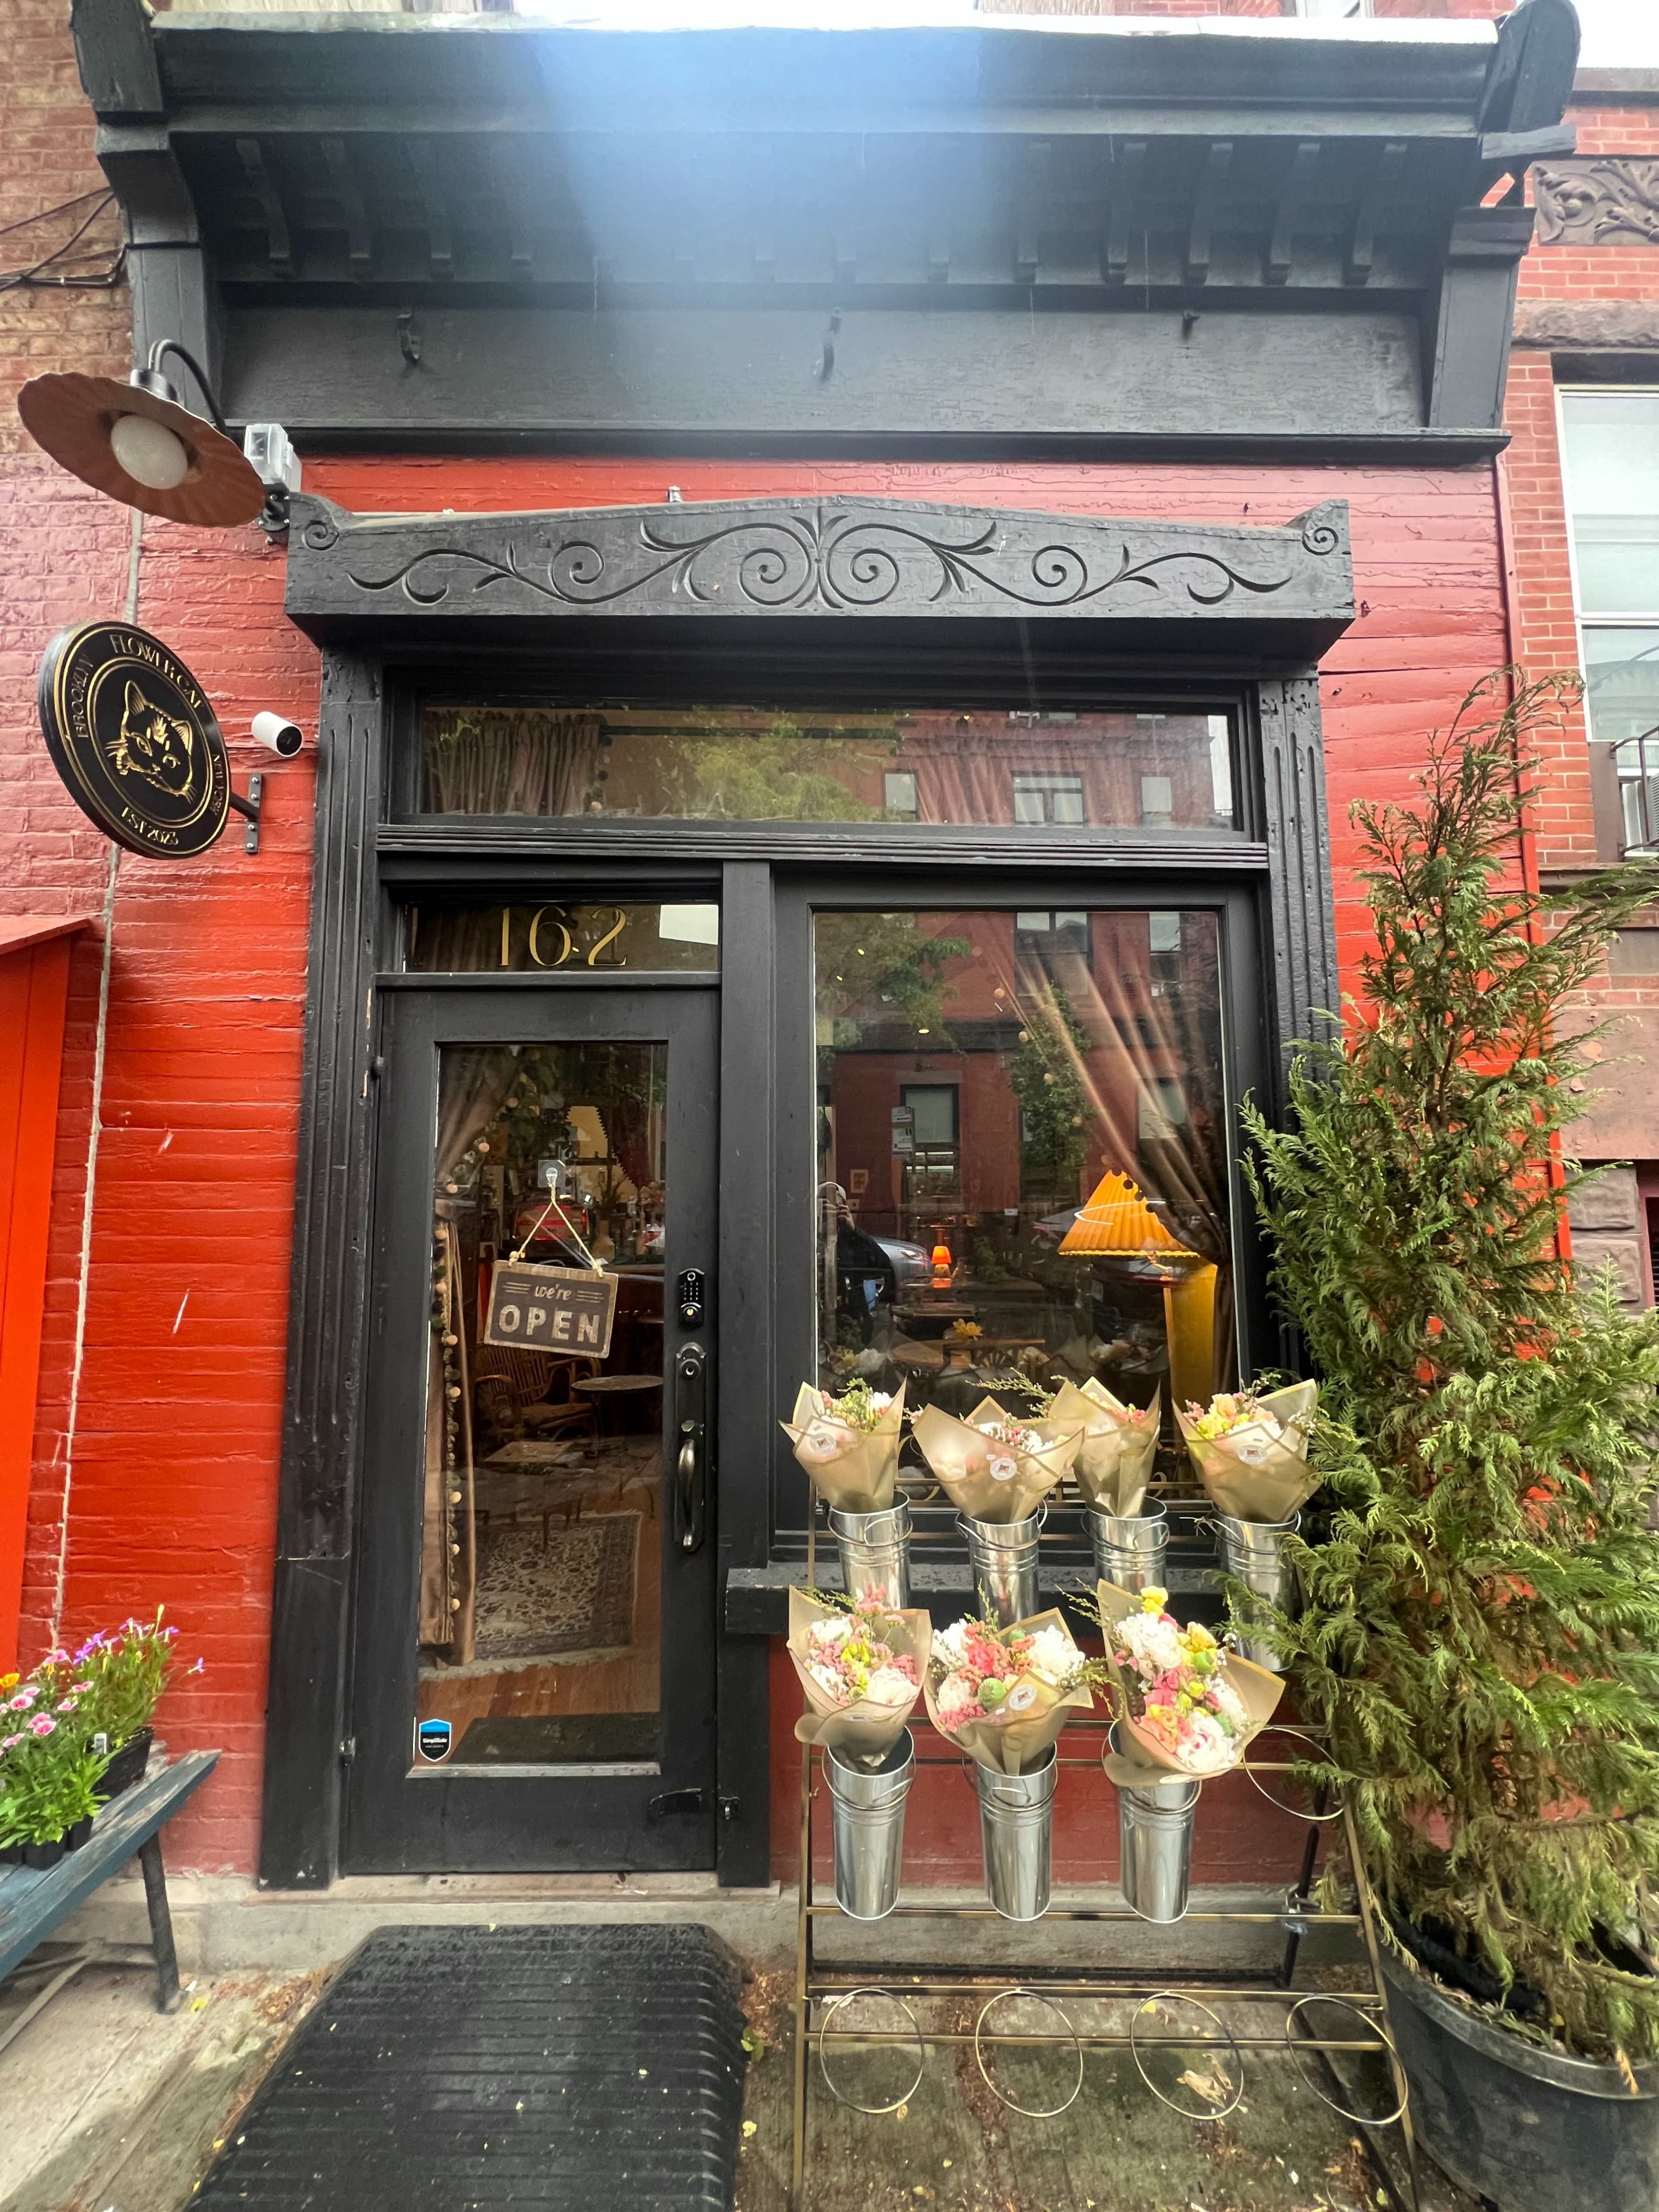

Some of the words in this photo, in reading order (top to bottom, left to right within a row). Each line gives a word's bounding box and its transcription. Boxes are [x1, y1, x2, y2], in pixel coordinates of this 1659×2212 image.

[147, 826, 178, 845] 2023
[499, 906, 627, 966] 162
[534, 1283, 572, 1301] we're
[499, 1304, 600, 1344] OPEN
